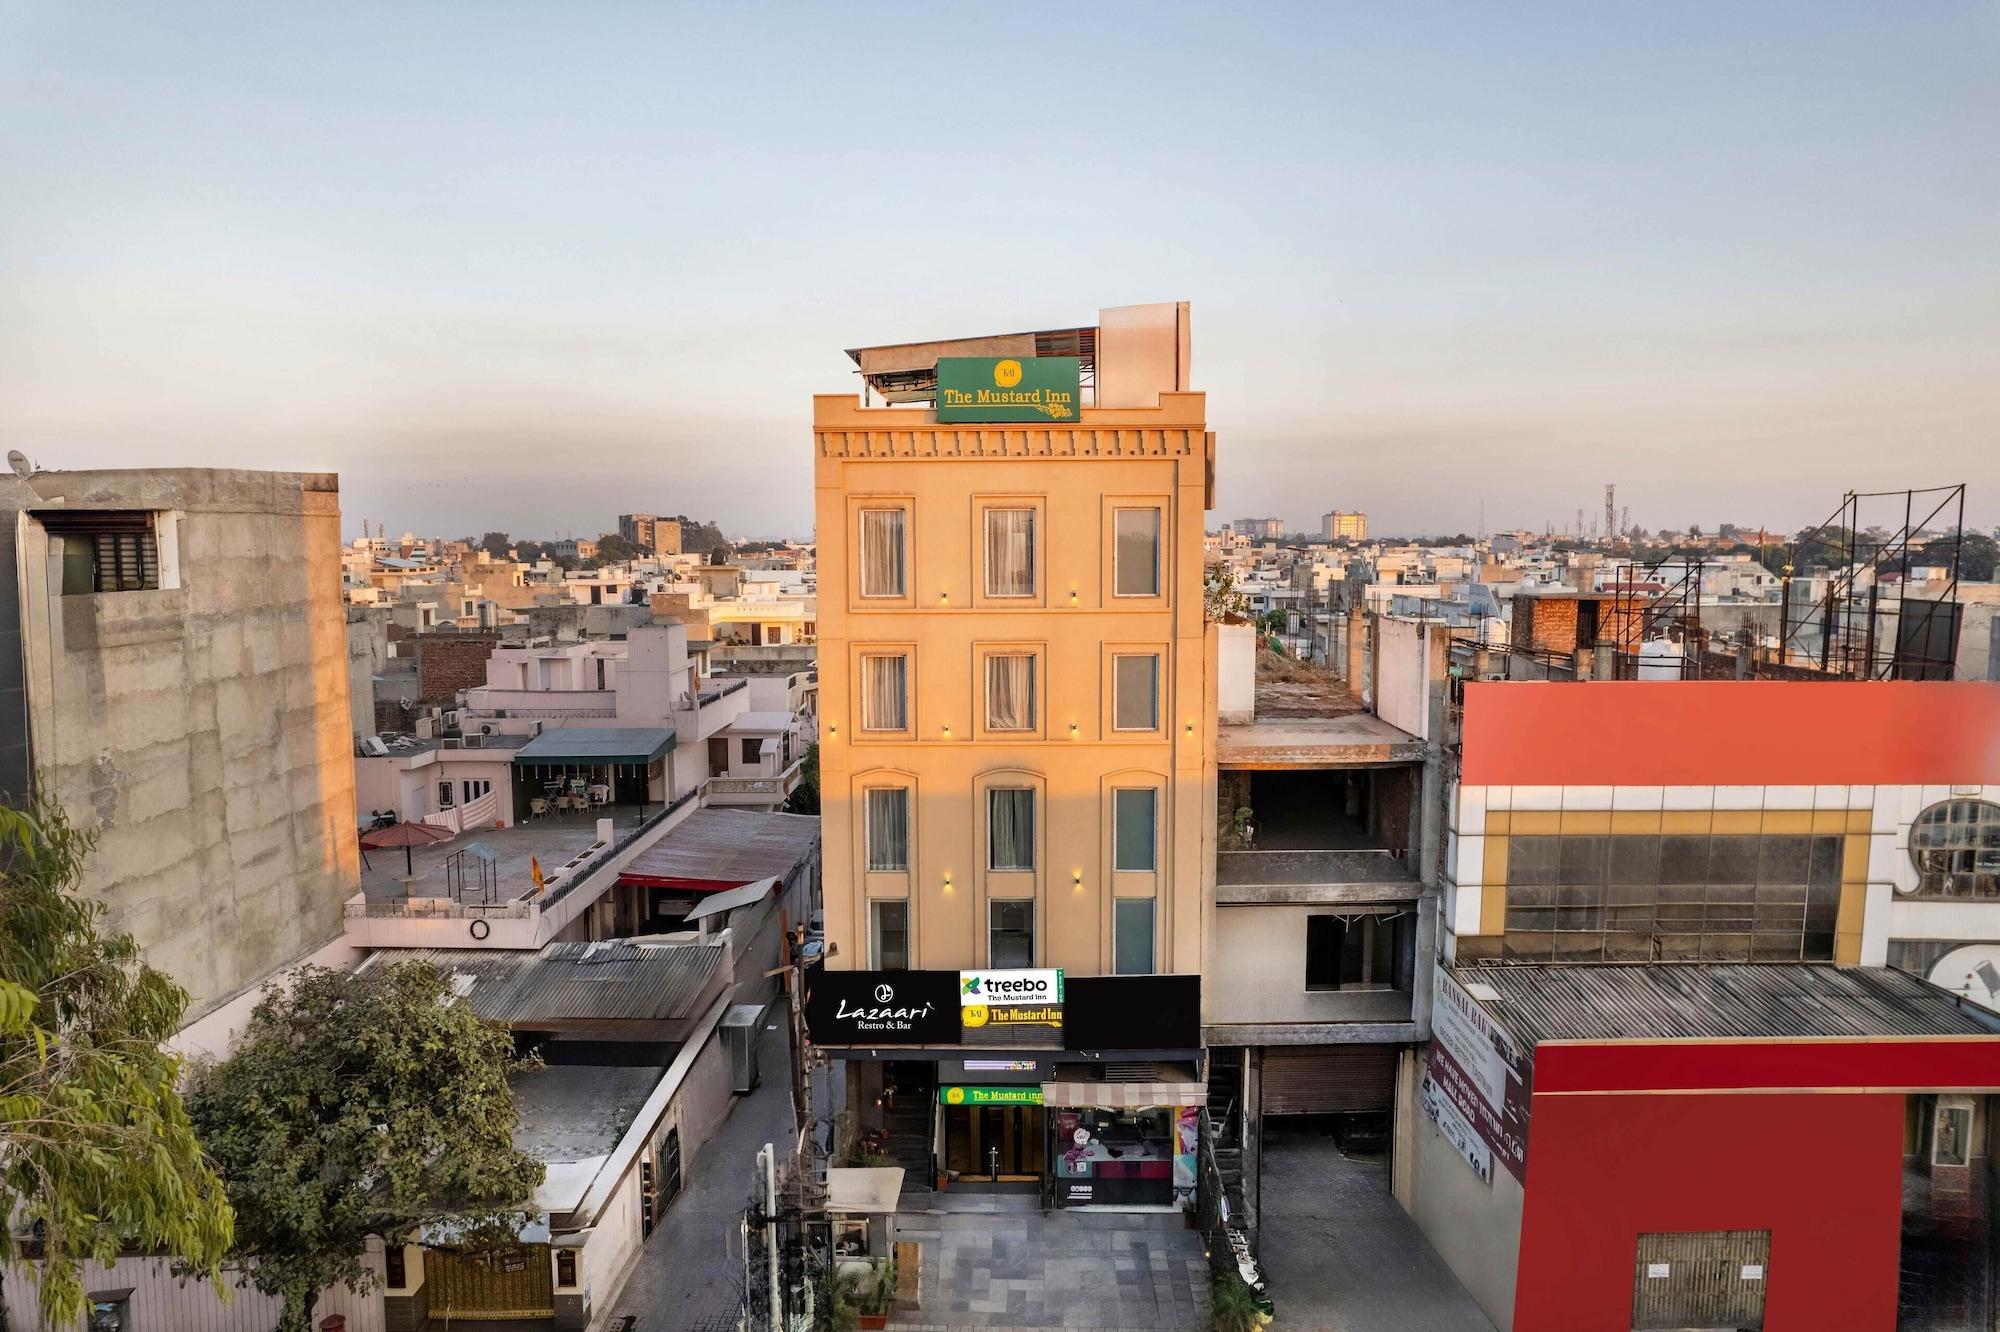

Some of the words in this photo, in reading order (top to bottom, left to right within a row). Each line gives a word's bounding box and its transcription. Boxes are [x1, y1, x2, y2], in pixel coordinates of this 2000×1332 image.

[944, 389, 972, 403] The
[977, 389, 1041, 403] Mustard
[1045, 389, 1071, 403] Inn
[984, 978, 1048, 993] treebo
[987, 994, 1002, 1002] The
[1441, 975, 1470, 1019] BANSAL
[990, 1008, 1009, 1021] The
[1009, 1008, 1047, 1021] Mustard
[1047, 1007, 1063, 1020] Inn
[857, 1020, 885, 1030] Restro
[885, 1020, 896, 1030] &
[896, 1020, 912, 1030] Bar
[1435, 1048, 1445, 1069] WE
[1443, 1058, 1459, 1087] HAVE
[1458, 1074, 1478, 1110] MOVED
[973, 1090, 989, 1099] The
[991, 1090, 1026, 1099] Mustard
[1442, 1074, 1458, 1102] MALL
[1457, 1092, 1475, 1124] ROAD
